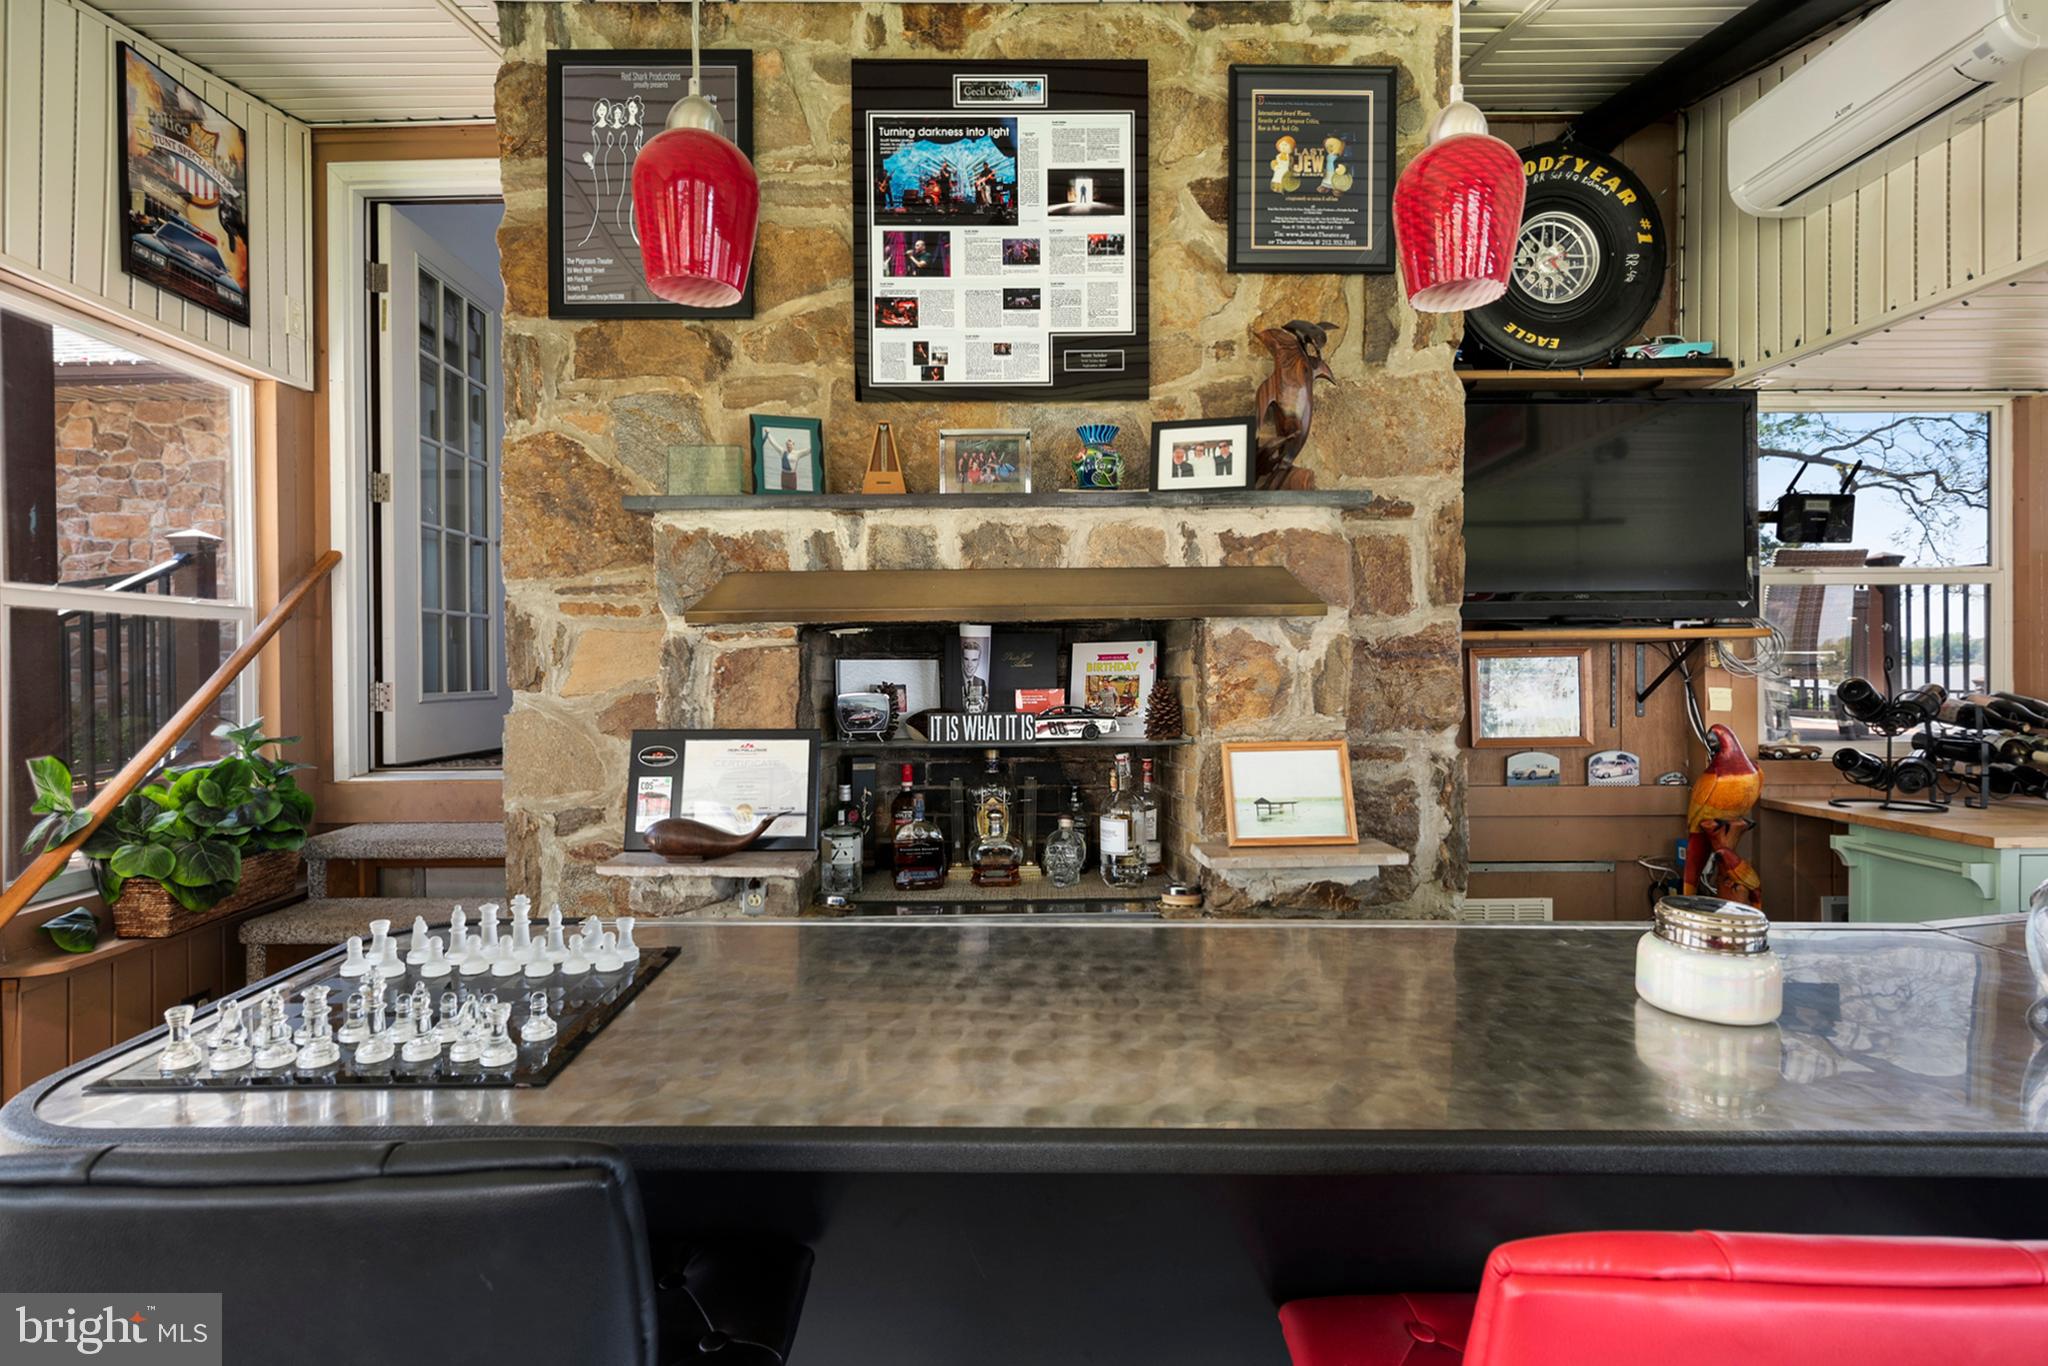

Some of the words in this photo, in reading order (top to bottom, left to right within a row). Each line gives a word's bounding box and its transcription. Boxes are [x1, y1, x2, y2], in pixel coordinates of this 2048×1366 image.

[621, 72, 631, 81] Red
[632, 72, 648, 81] Shark
[649, 71, 681, 81] Productions
[964, 86, 986, 96] Cecil
[879, 127, 915, 138] Turning
[917, 127, 963, 137] darkness
[966, 127, 985, 137] into
[987, 127, 1010, 139] light
[1294, 148, 1325, 156] LAST
[1293, 155, 1325, 173] JEW
[1524, 155, 1637, 206] ODYEAR
[1637, 218, 1653, 244] #1
[1503, 321, 1560, 349] EAGLE
[1086, 661, 1139, 672] BIRTHDAY
[930, 715, 943, 742] IT
[946, 715, 959, 742] IS
[962, 714, 1002, 741] WHAT
[1005, 714, 1018, 741] IT
[1021, 714, 1034, 741] IS
